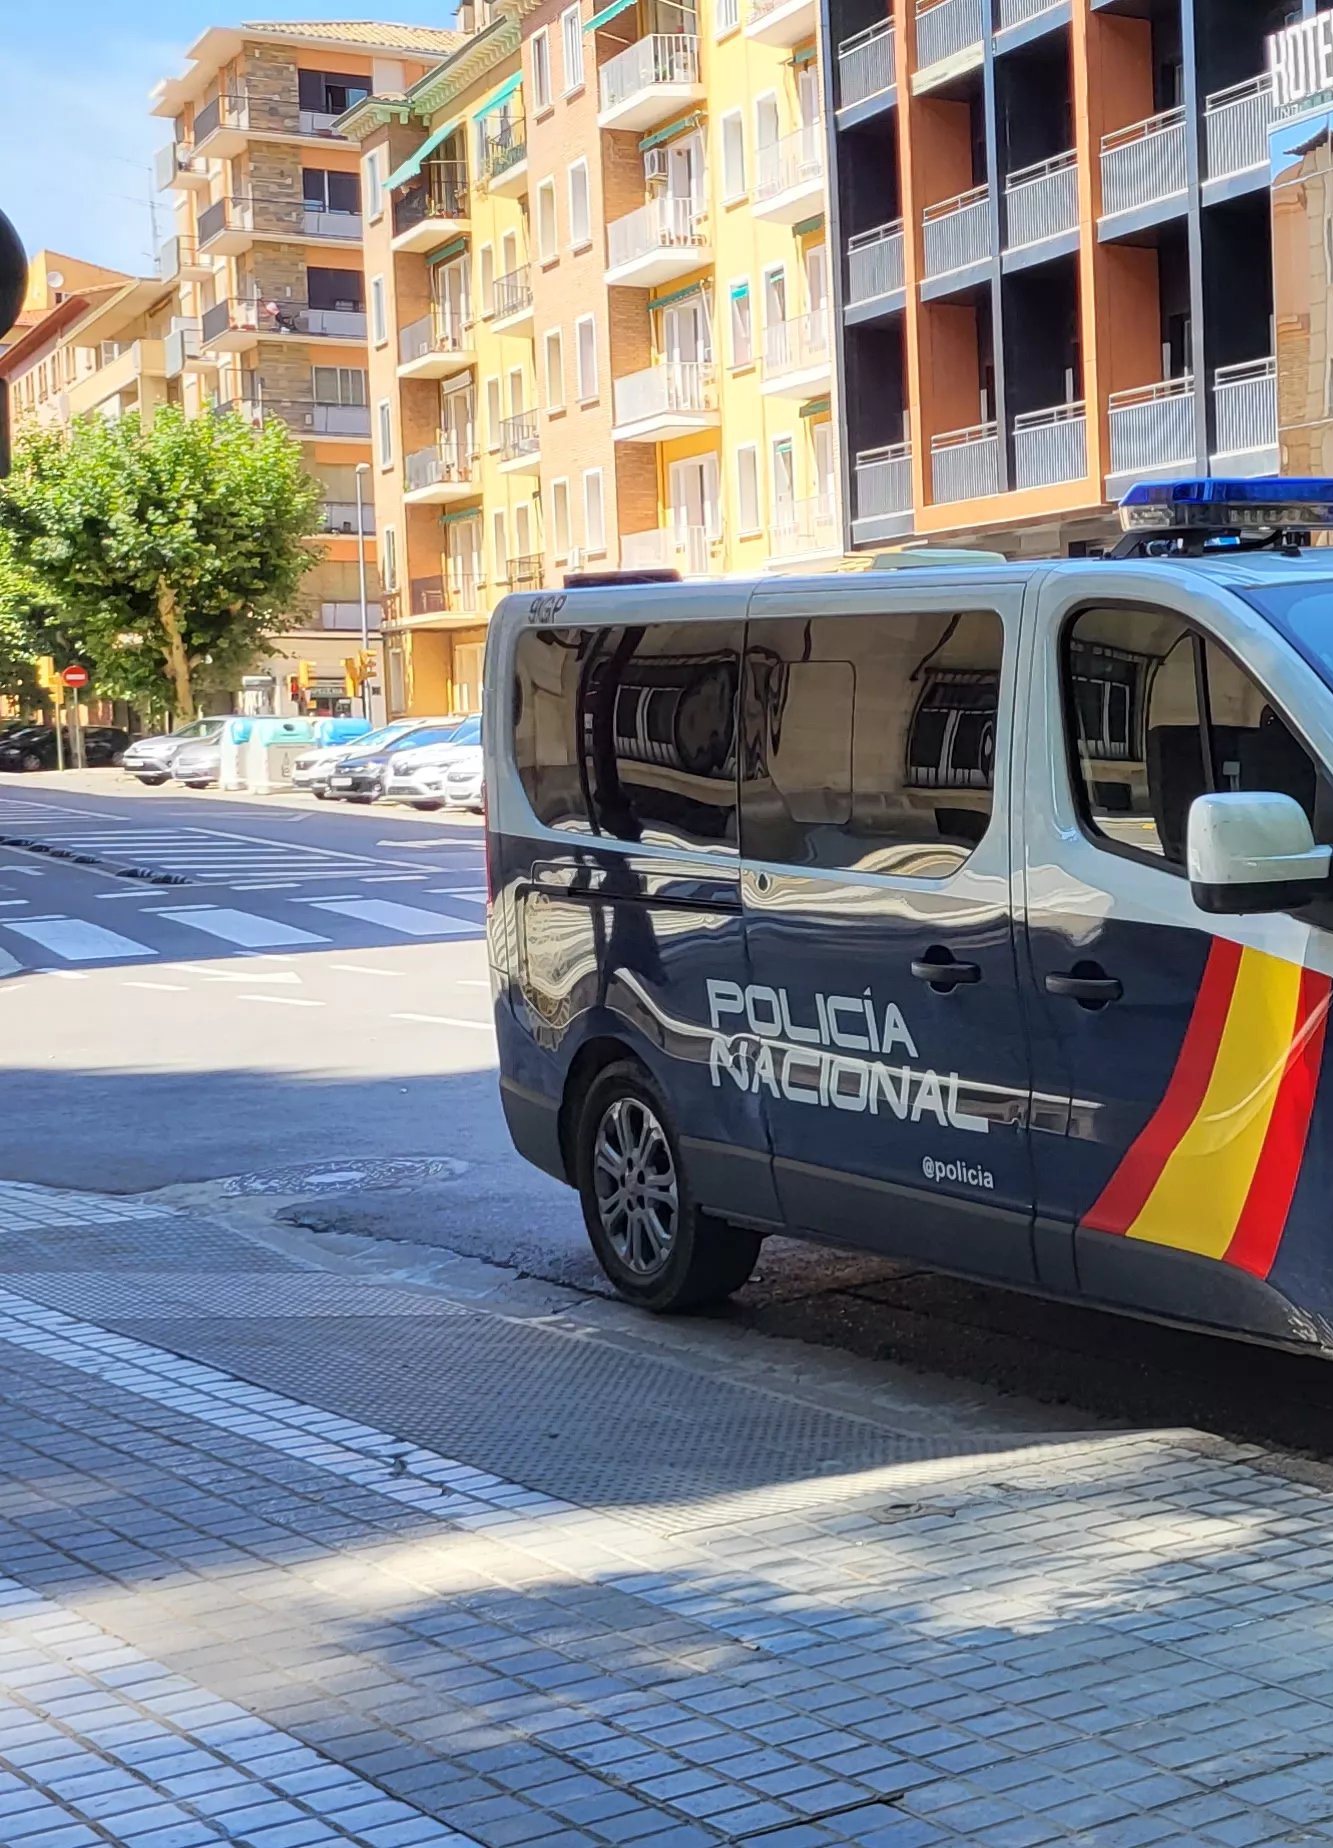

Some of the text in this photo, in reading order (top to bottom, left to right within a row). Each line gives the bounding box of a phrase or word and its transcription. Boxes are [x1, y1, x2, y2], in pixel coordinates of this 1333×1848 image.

[706, 978, 919, 1058] POLICÍA
[709, 1037, 989, 1133] NACIONAL
[921, 1155, 994, 1190] @policia
